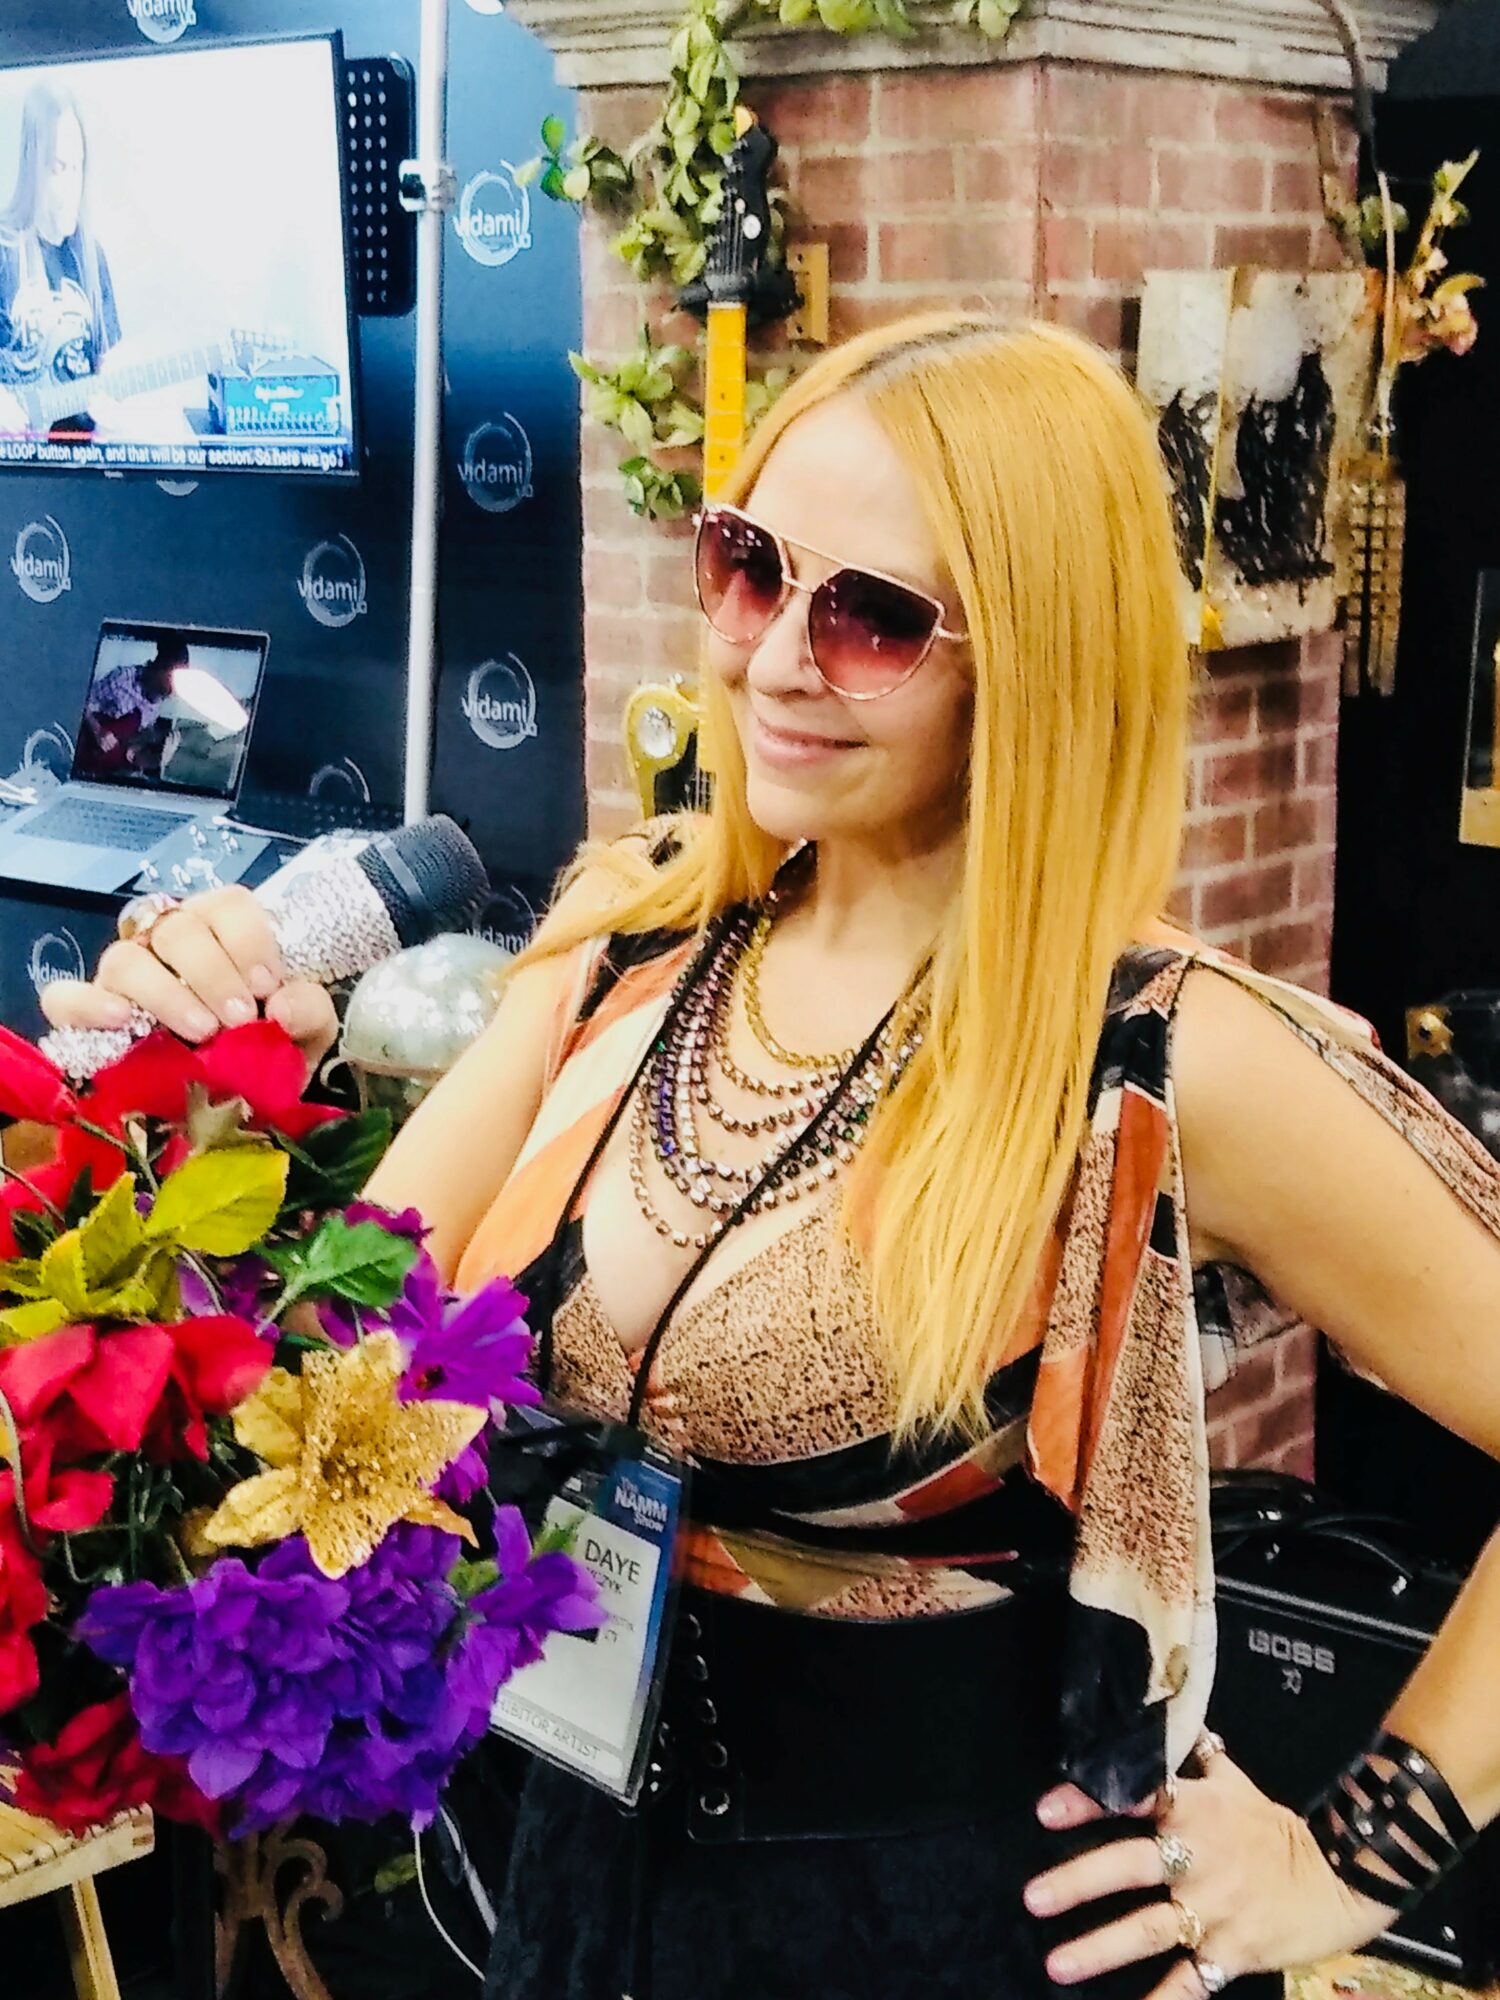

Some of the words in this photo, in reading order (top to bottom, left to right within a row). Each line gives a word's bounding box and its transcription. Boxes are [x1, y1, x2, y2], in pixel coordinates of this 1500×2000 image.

[7, 443, 36, 460] LOOP
[38, 444, 71, 461] button
[73, 445, 104, 464] again,
[105, 446, 126, 462] and
[128, 446, 150, 463] that
[151, 446, 170, 464] will
[172, 447, 186, 464] be
[188, 450, 206, 464] our
[301, 449, 320, 467] we
[457, 457, 523, 484] vidami
[10, 552, 63, 578] vidami
[297, 575, 357, 601] vidami
[461, 692, 527, 722] vidami
[614, 1485, 668, 1523] NAMM
[585, 1538, 641, 1585] DAYE
